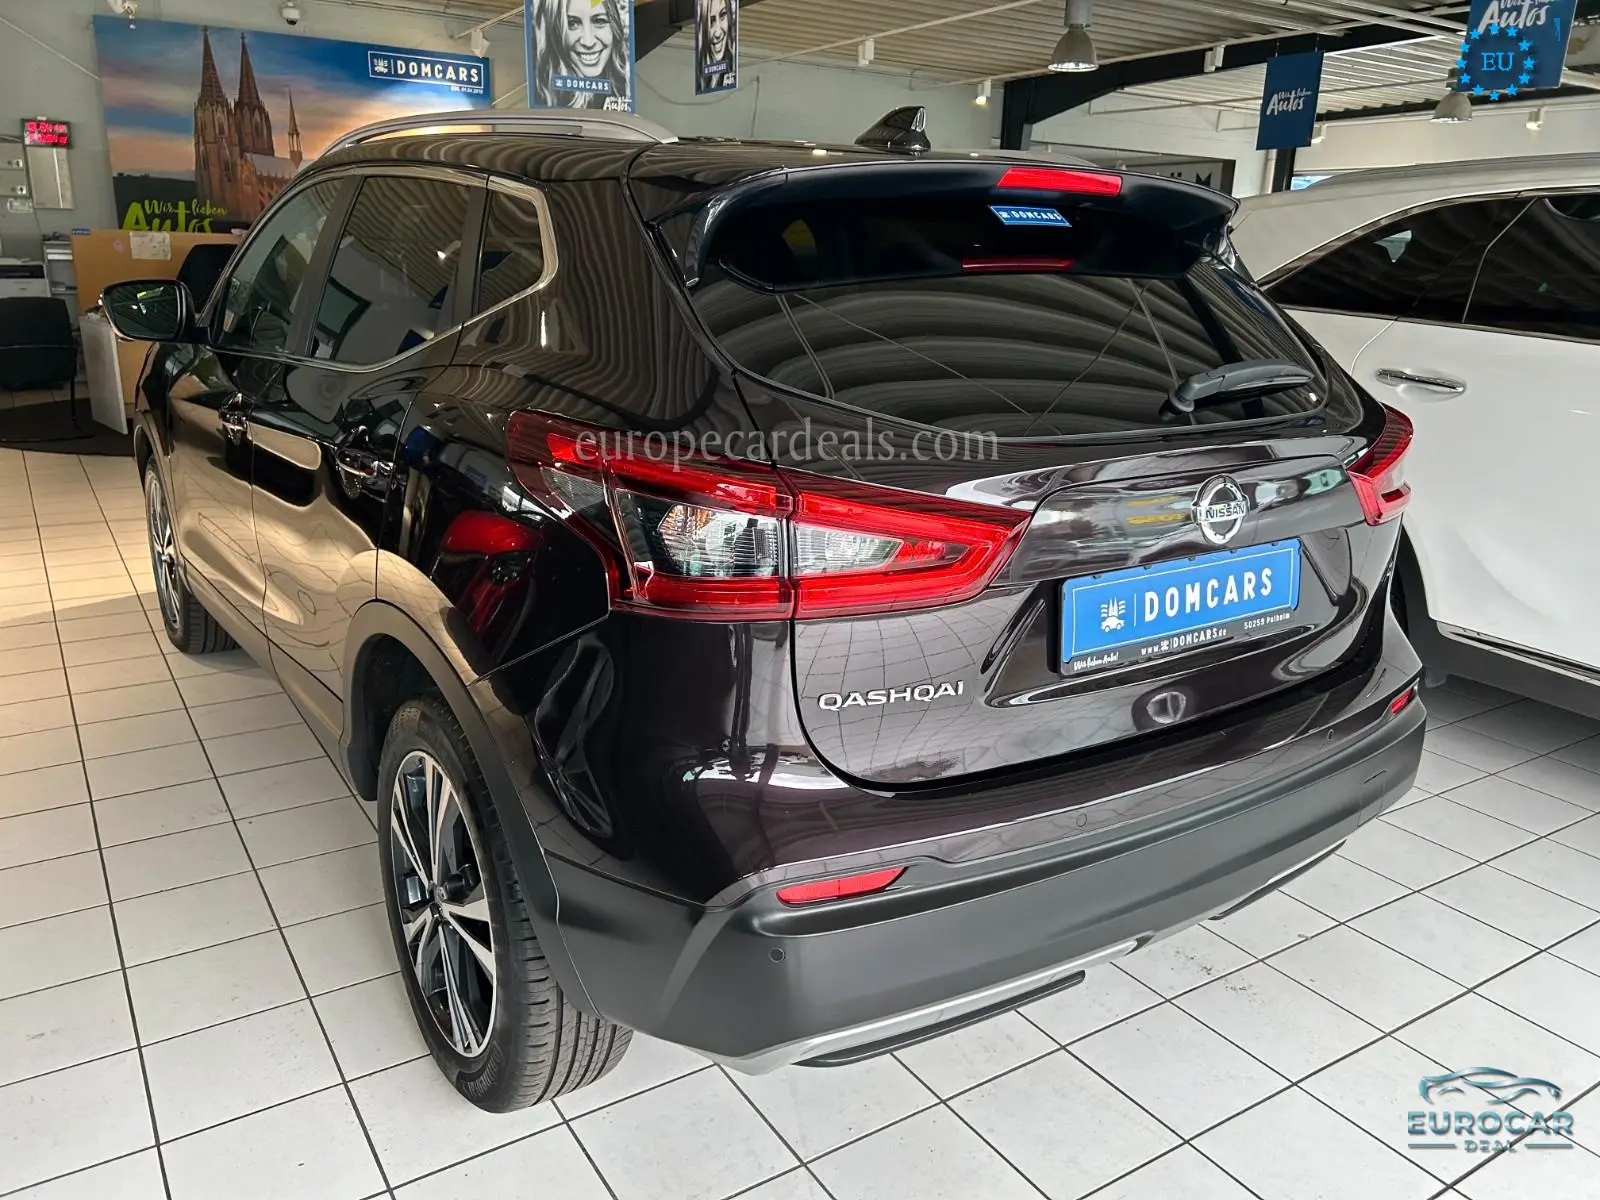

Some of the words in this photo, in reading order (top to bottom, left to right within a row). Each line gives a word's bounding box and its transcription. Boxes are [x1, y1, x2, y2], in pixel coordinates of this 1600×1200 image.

[396, 60, 479, 83] DOMCARS
[566, 79, 609, 91] DOMCARS
[1266, 89, 1304, 116] Autos
[191, 198, 227, 216] lieben
[1205, 502, 1245, 519] NISSAN
[1144, 567, 1273, 622] DOMCARS
[1243, 617, 1265, 630] 50259
[818, 680, 965, 712] QASHQAI
